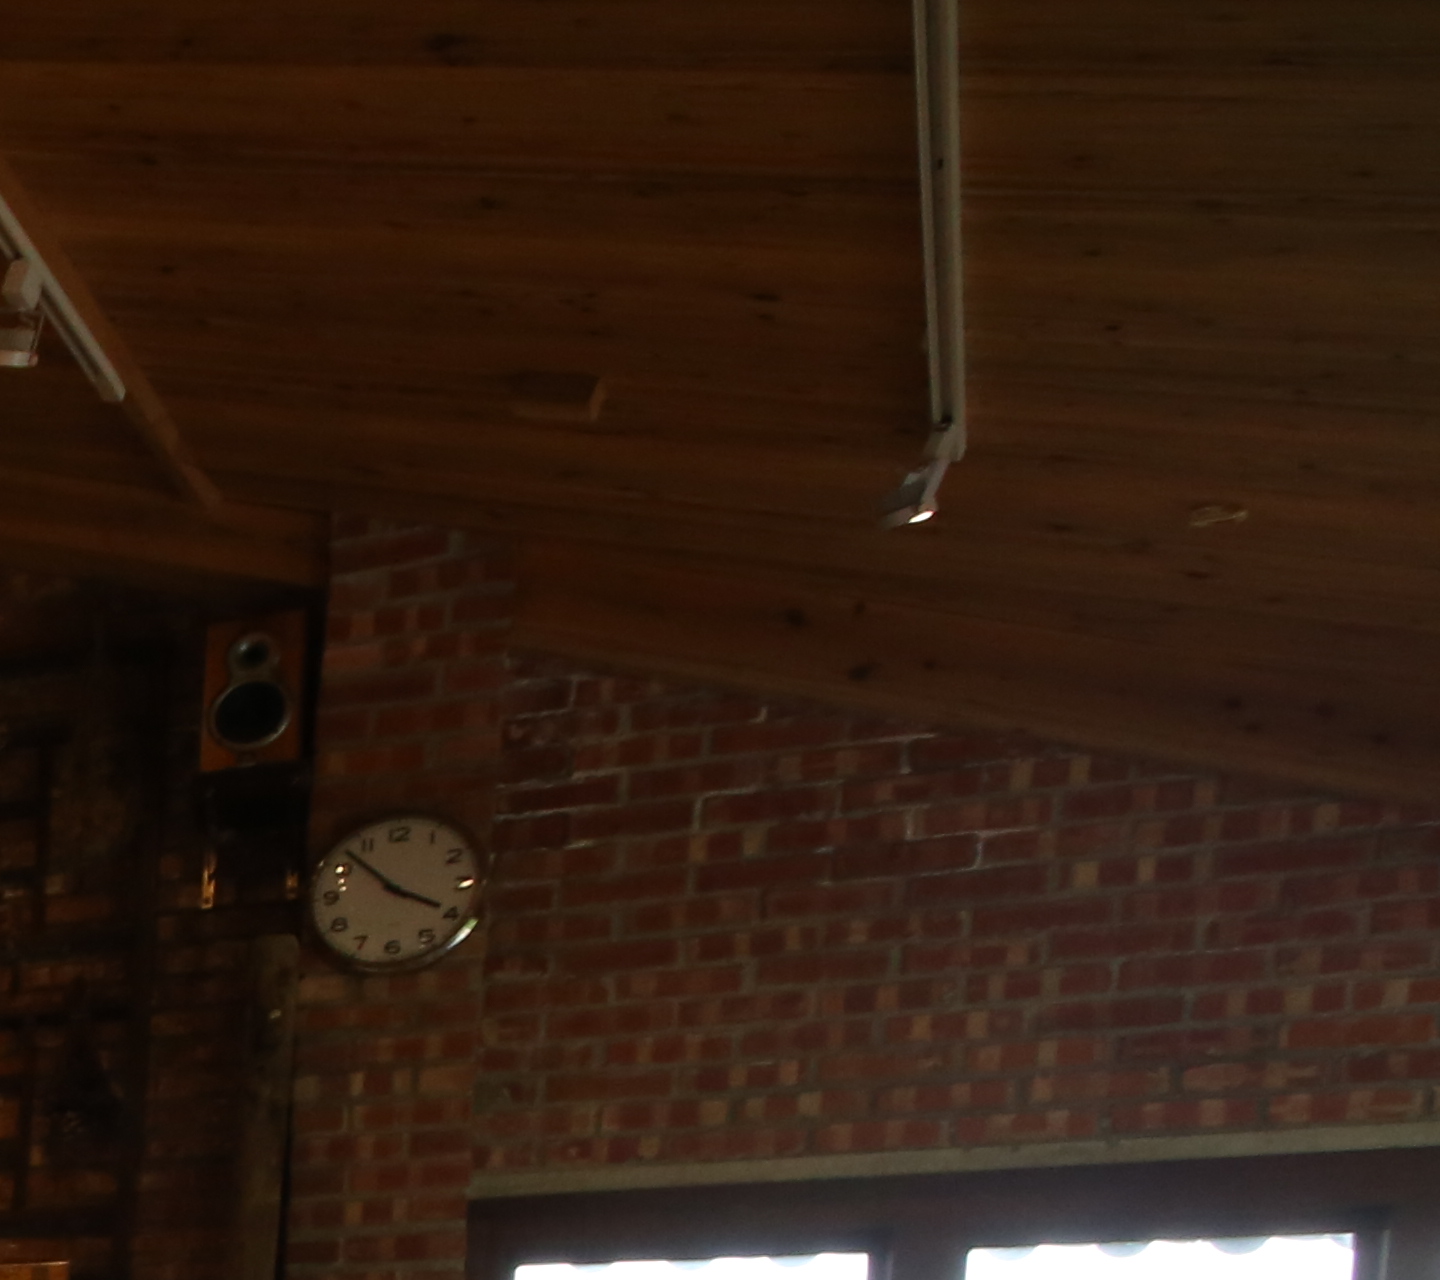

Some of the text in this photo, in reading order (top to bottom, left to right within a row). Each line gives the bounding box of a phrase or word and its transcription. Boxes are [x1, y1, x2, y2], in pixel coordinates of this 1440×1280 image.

[388, 827, 411, 842] 12
[447, 849, 462, 864] 2
[442, 906, 459, 920] 4
[353, 936, 368, 950] 7
[418, 929, 434, 944] 5
[384, 939, 401, 954] 6
